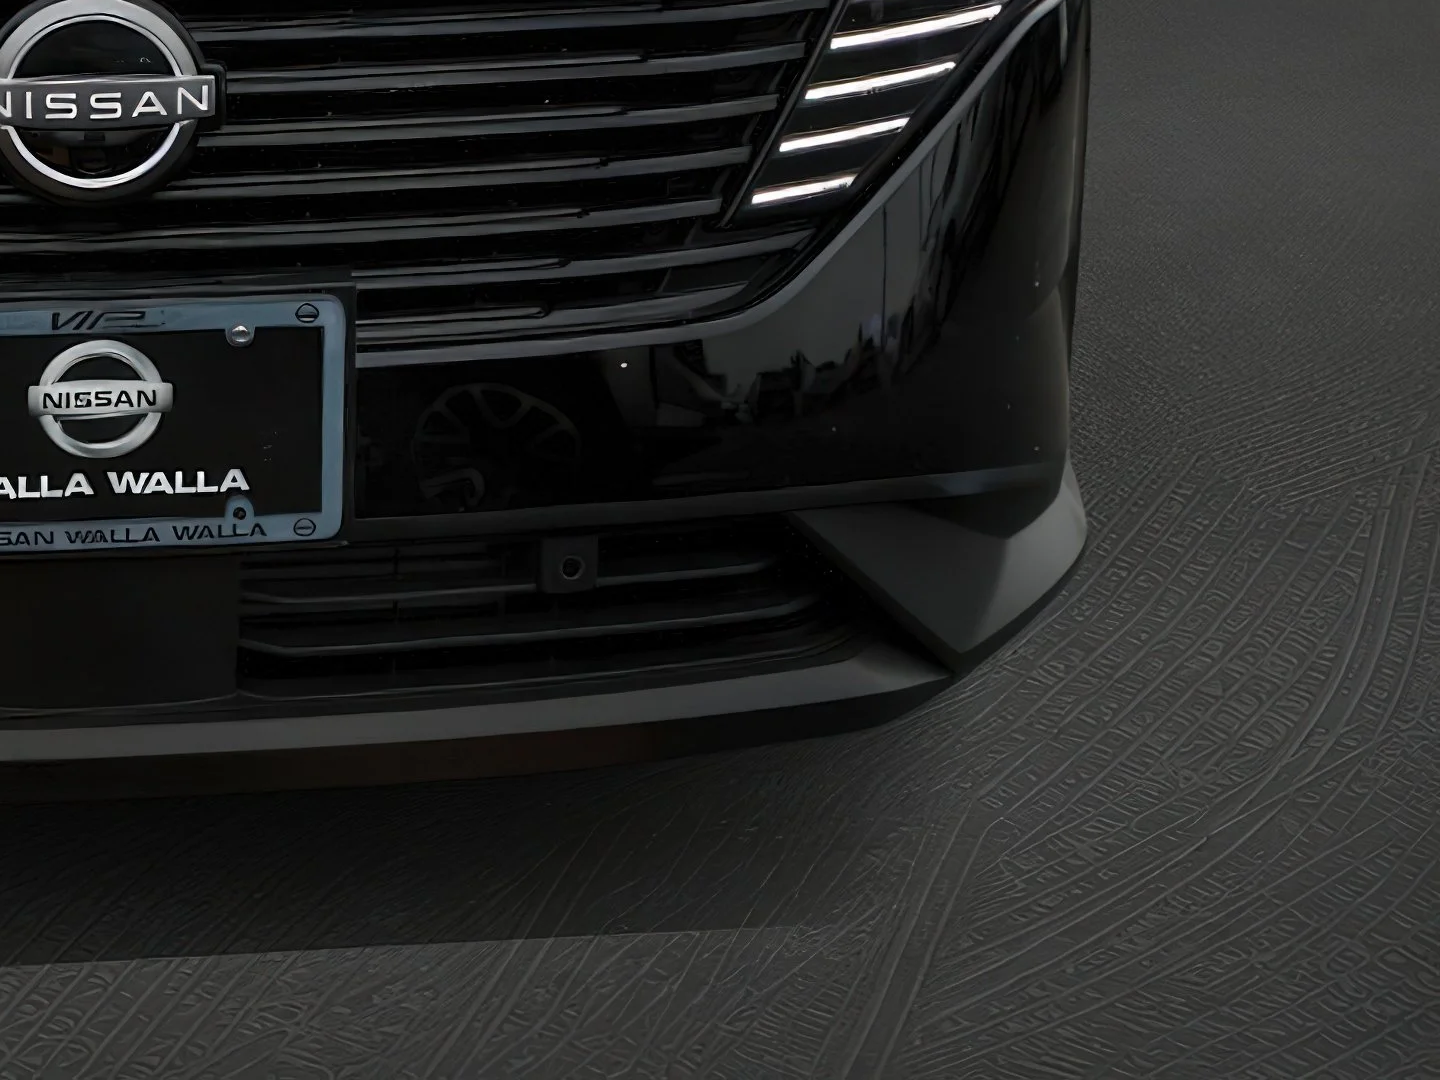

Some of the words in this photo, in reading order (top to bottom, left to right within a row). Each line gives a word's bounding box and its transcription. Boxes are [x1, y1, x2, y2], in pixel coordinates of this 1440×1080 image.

[42, 388, 158, 410] NISSAN
[106, 468, 250, 495] WALLA
[65, 526, 160, 545] WALLA
[172, 522, 267, 541] WALLA
